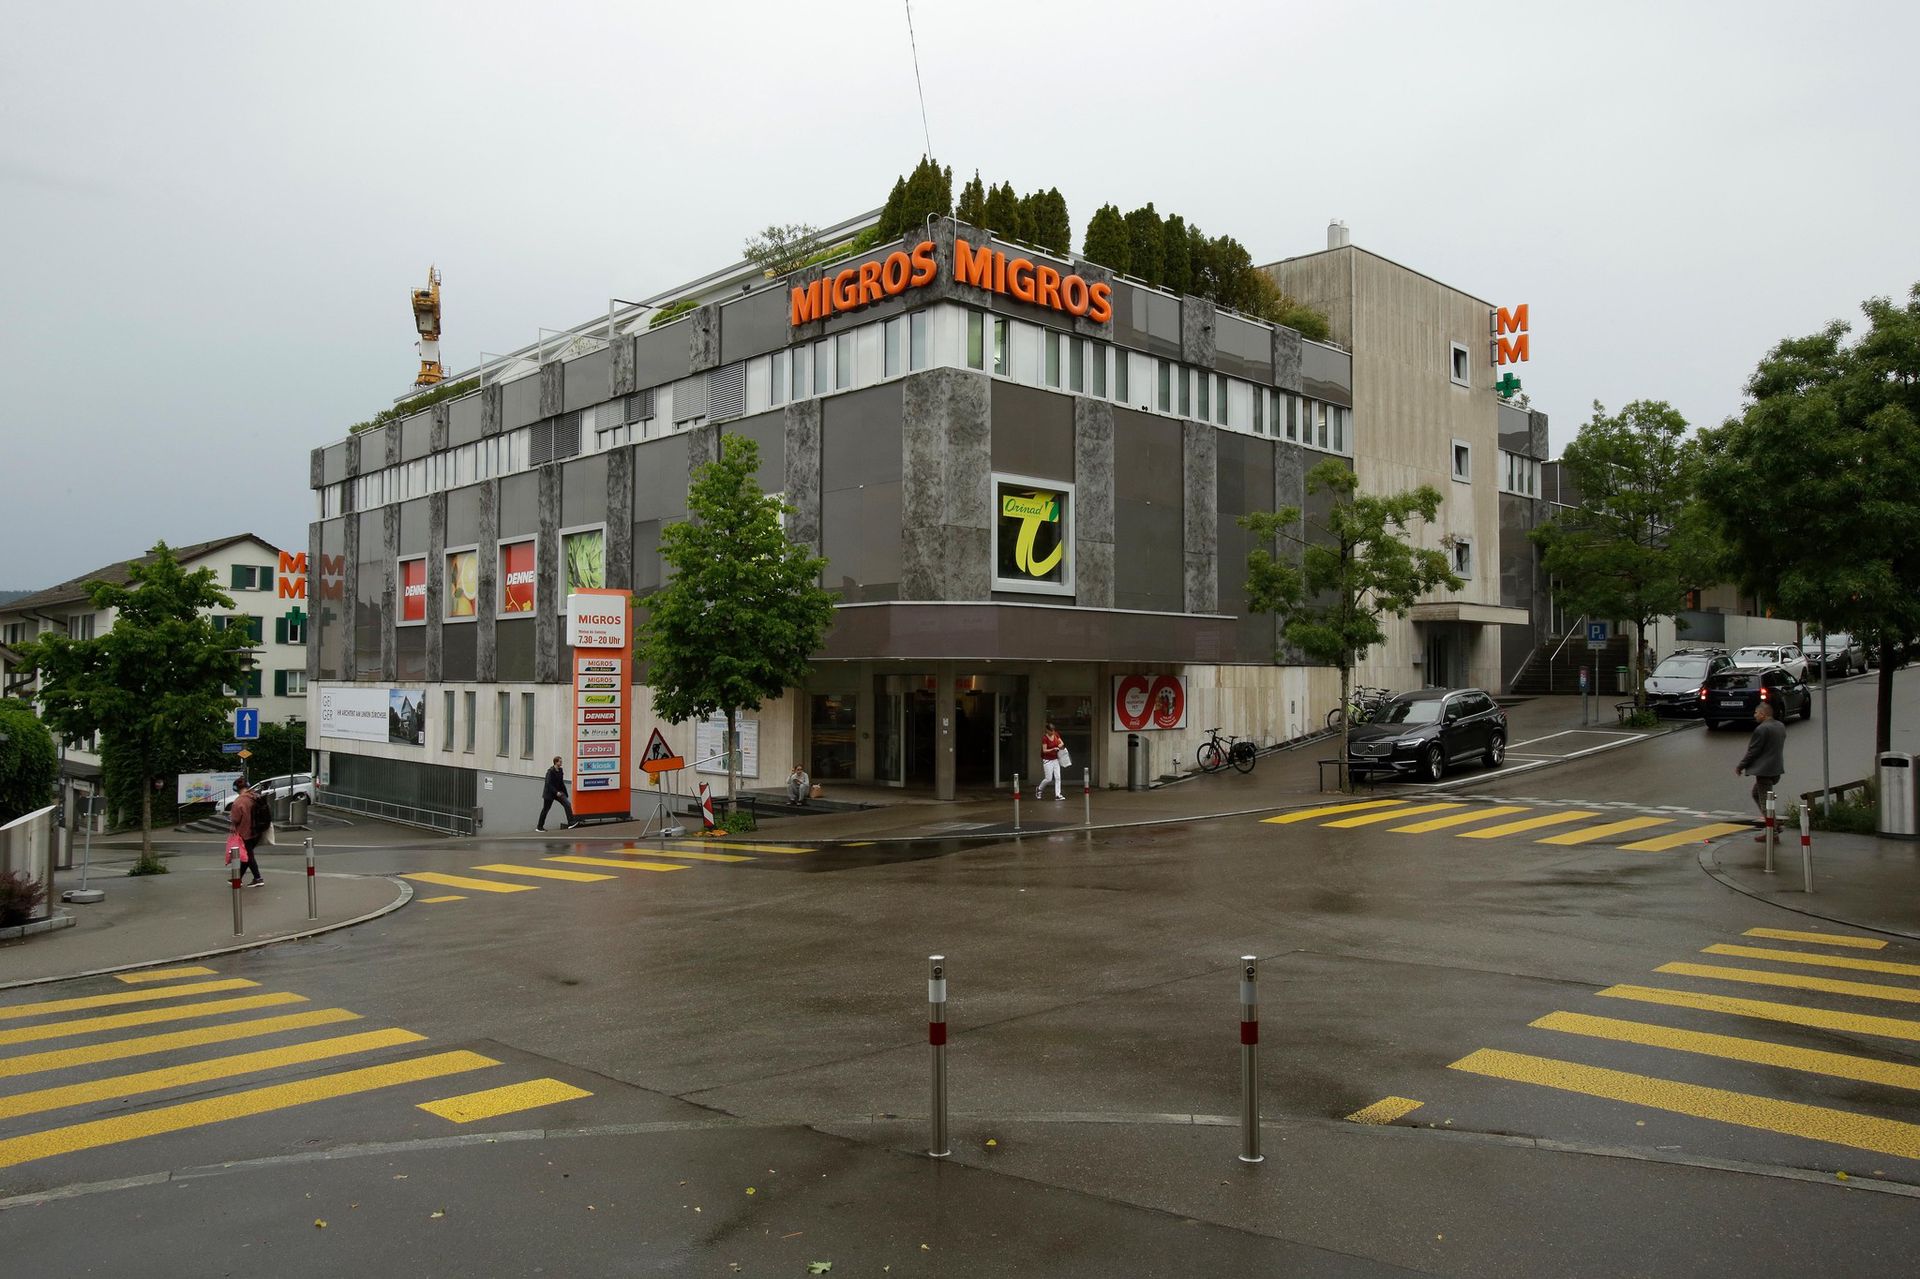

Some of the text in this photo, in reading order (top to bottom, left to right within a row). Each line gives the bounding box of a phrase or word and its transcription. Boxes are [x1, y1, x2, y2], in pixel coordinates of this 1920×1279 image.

[791, 240, 937, 327] MIGROS
[954, 238, 1112, 324] MIGROS
[1497, 304, 1528, 335] M
[1498, 334, 1529, 366] M
[279, 552, 306, 574] M
[279, 577, 305, 599] M
[578, 614, 621, 625] MIGROS
[578, 635, 592, 644] 7.30
[599, 635, 607, 644] 20
[608, 636, 621, 645] Uhr
[586, 745, 613, 753] zebra
